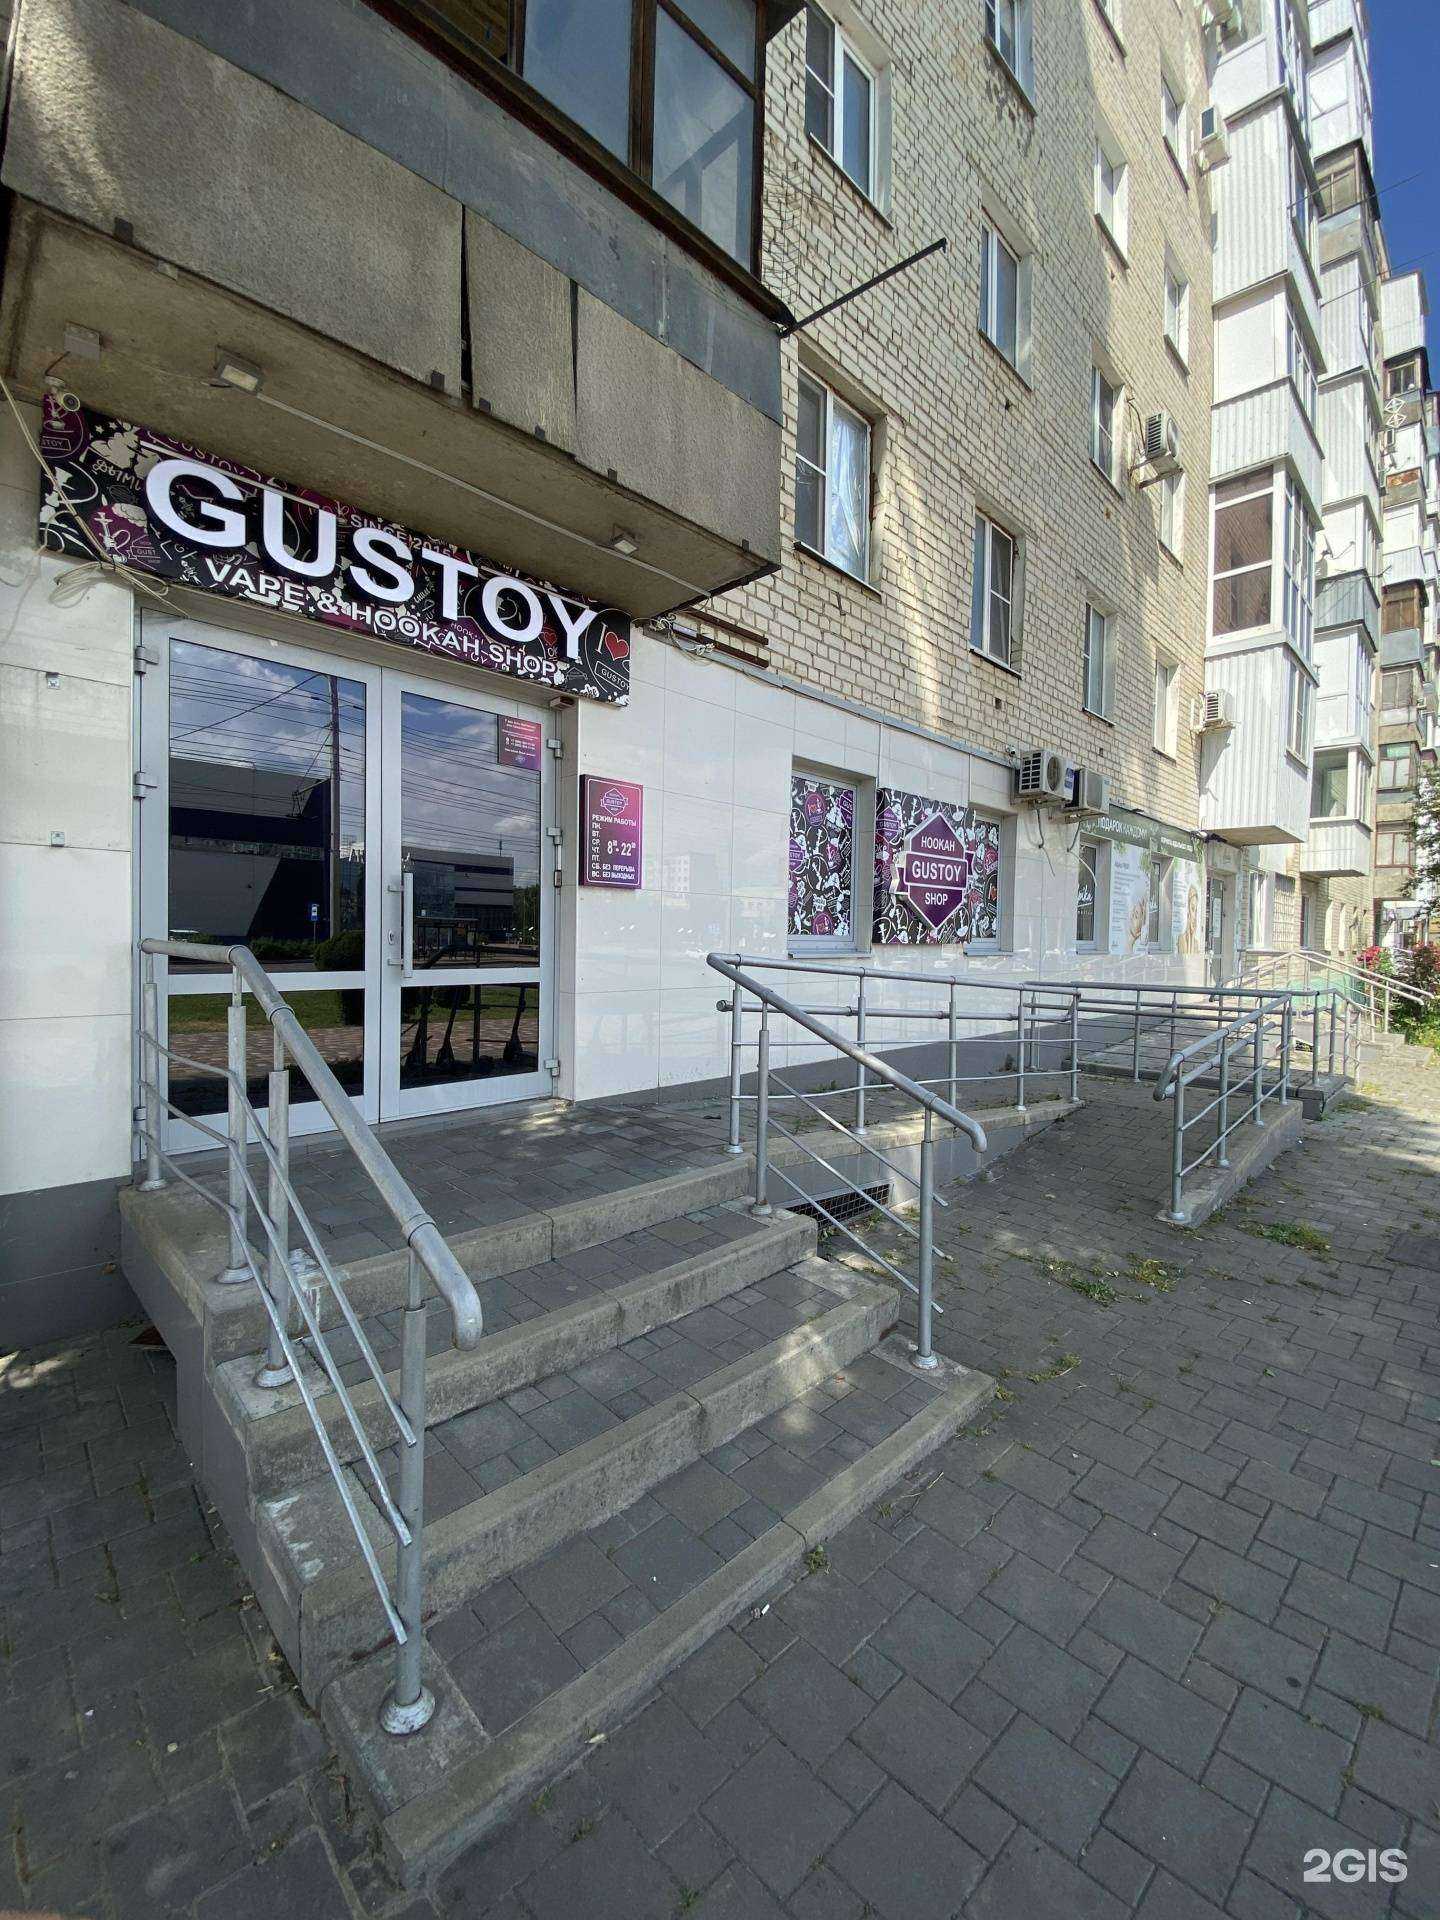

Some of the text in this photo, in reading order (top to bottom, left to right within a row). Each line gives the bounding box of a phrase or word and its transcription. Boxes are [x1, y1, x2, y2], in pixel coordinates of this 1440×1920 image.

[146, 459, 598, 661] GUSTOY
[204, 557, 305, 606] VAPE
[352, 602, 480, 656] HOOKAH
[489, 644, 556, 677] SHOP
[592, 814, 636, 826] РЕЖИМ РАБОТЫ
[921, 835, 955, 852] HOOKAH
[912, 860, 962, 882] GUSTOY
[924, 892, 949, 906] SHOP
